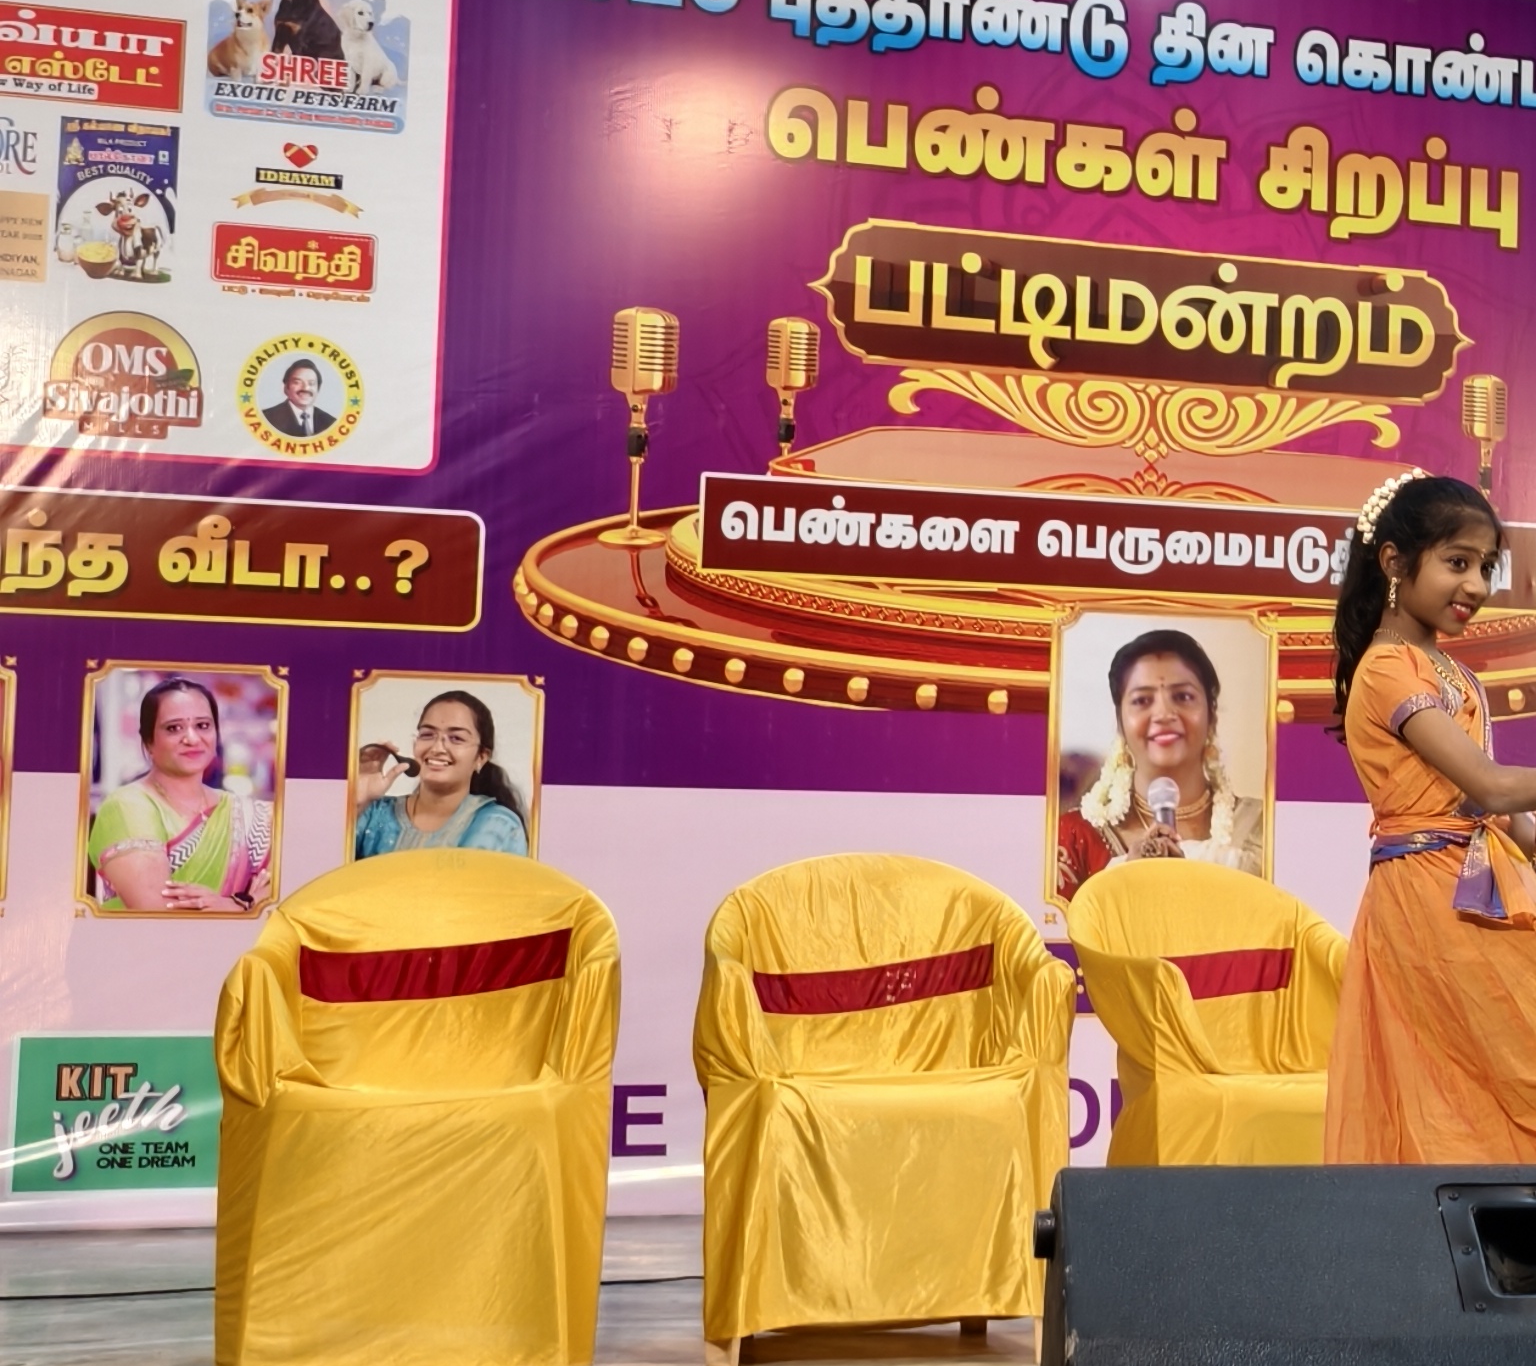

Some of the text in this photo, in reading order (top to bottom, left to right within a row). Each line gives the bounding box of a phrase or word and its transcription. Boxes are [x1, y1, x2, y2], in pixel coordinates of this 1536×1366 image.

[1150, 1, 1275, 85] தின
[5, 50, 164, 87] எஸ்டேட்
[12, 77, 43, 93] Way
[48, 81, 64, 91] of
[67, 82, 95, 95] Life
[260, 53, 350, 88] SHREE
[214, 82, 398, 114] EXOTIC PETS FARM
[76, 163, 154, 186] BEST QUALITY
[259, 169, 336, 187] IDHAYAM
[768, 85, 1519, 249] பெண்கள் சிறப்பு
[225, 235, 362, 283] சிவந்தி
[853, 252, 1435, 388] பட்டிமன்றம்
[81, 341, 168, 377] OMS
[243, 337, 360, 391] QUALITY TRUST
[45, 382, 199, 423] Sivajothi
[243, 407, 325, 454] VASANTH
[720, 495, 1020, 555] பெண்களை
[0, 508, 129, 597] ந்த
[56, 1063, 139, 1101] KIT
[96, 1155, 197, 1169] ONE DREAM
[98, 1141, 190, 1155] ONE TEAM
